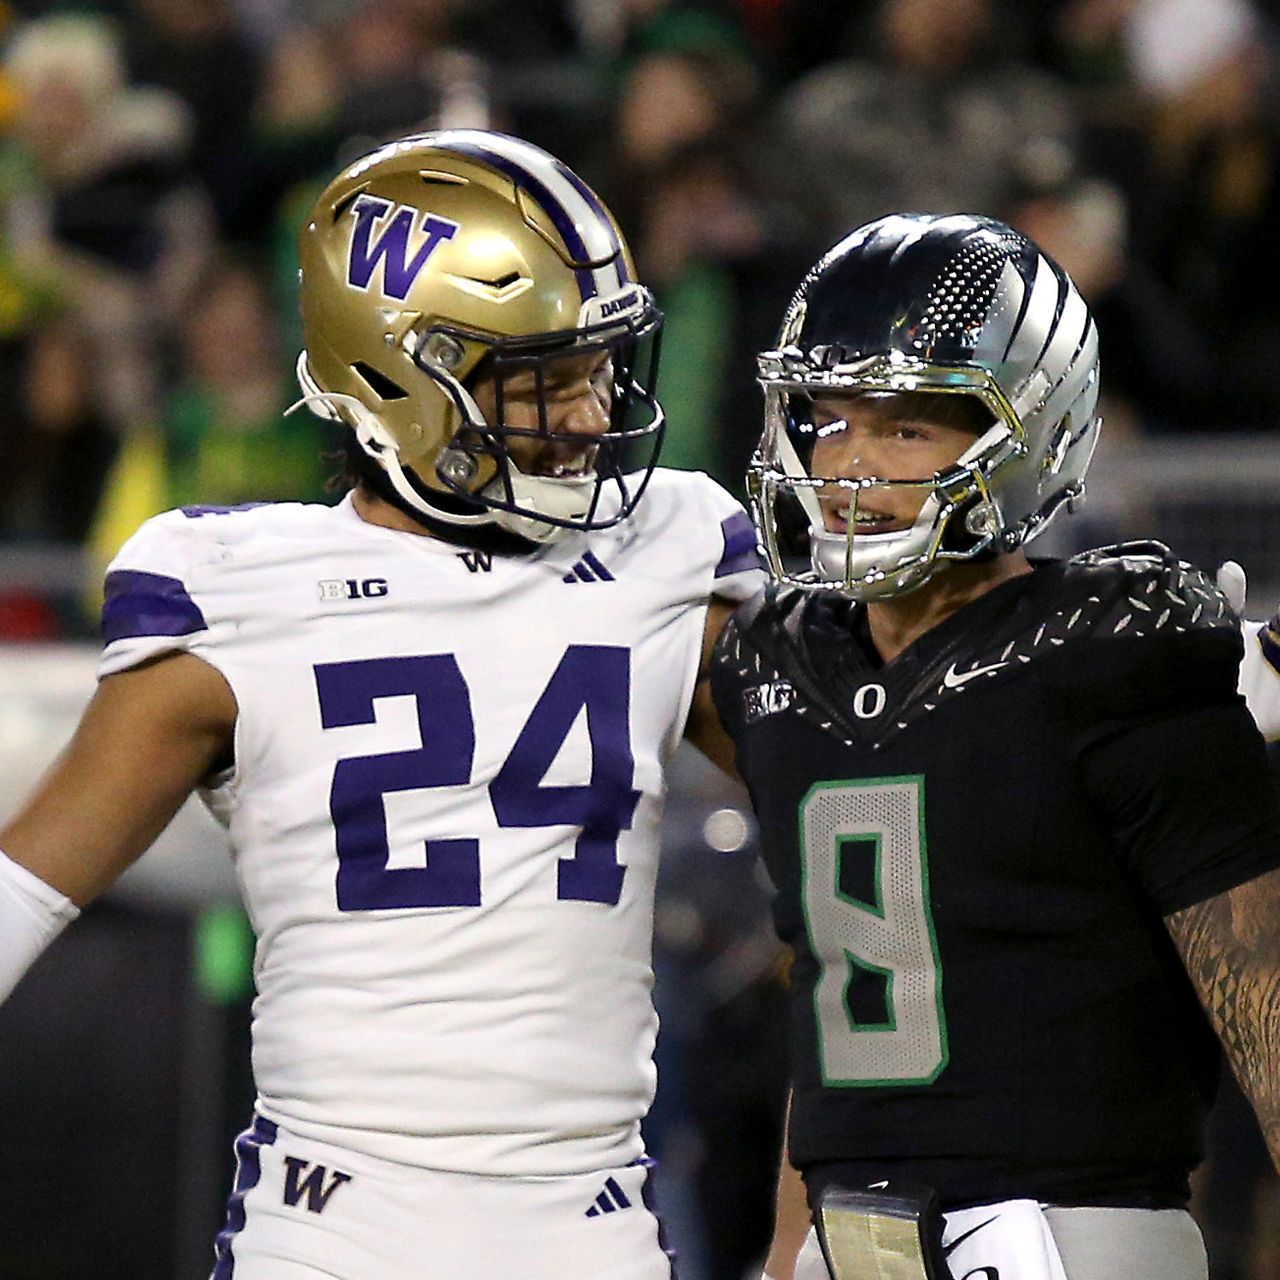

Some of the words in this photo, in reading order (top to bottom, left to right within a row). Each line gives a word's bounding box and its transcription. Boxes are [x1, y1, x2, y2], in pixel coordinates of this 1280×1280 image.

[347, 194, 461, 303] W
[456, 551, 493, 573] W
[853, 684, 886, 719] O
[312, 644, 642, 912] 24
[799, 773, 949, 1088] 8
[282, 1155, 352, 1215] W
